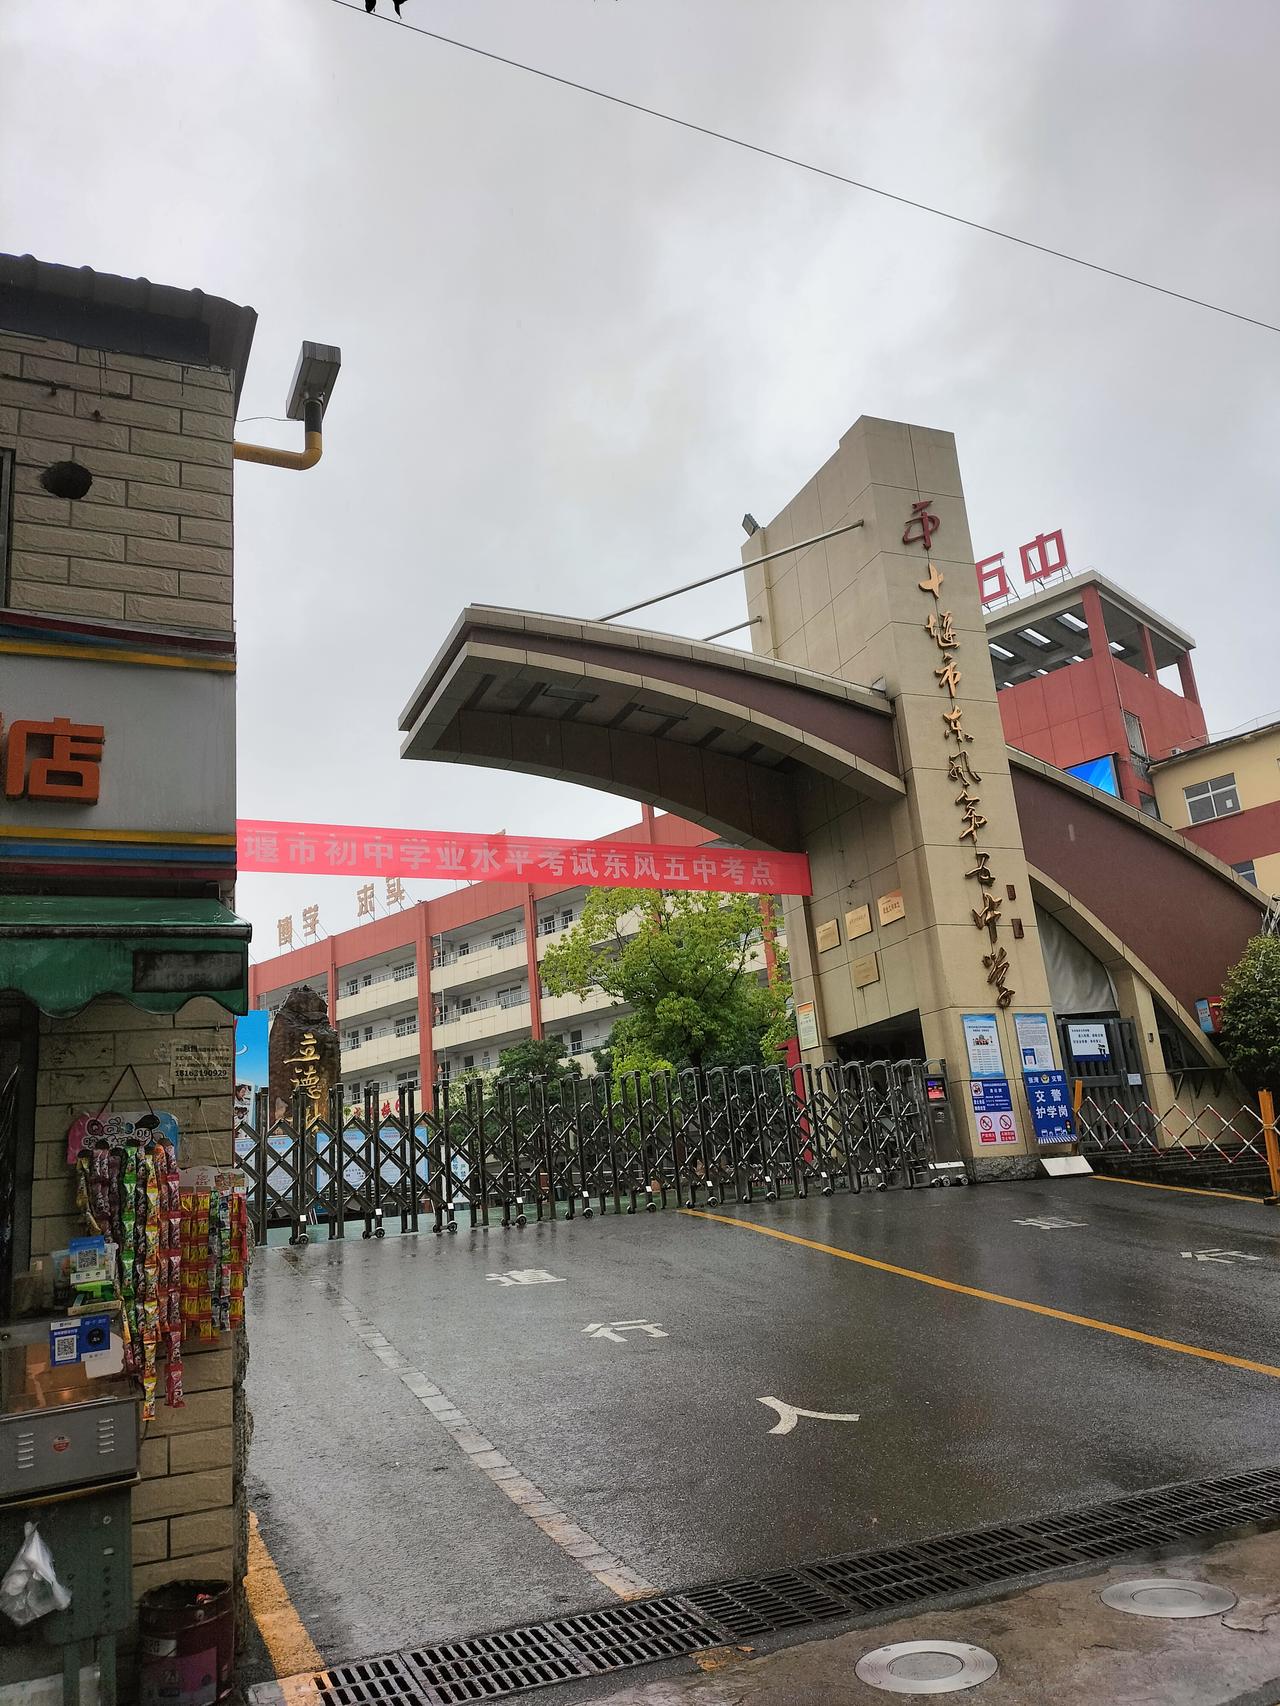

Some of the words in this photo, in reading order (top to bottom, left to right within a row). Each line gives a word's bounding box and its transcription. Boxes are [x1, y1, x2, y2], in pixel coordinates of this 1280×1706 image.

[0, 713, 104, 806] 店
[243, 829, 776, 887] 堰市初中学业水平考试东风五中考点
[1034, 1089, 1062, 1102] 交警
[1036, 1105, 1068, 1119] 护学岗
